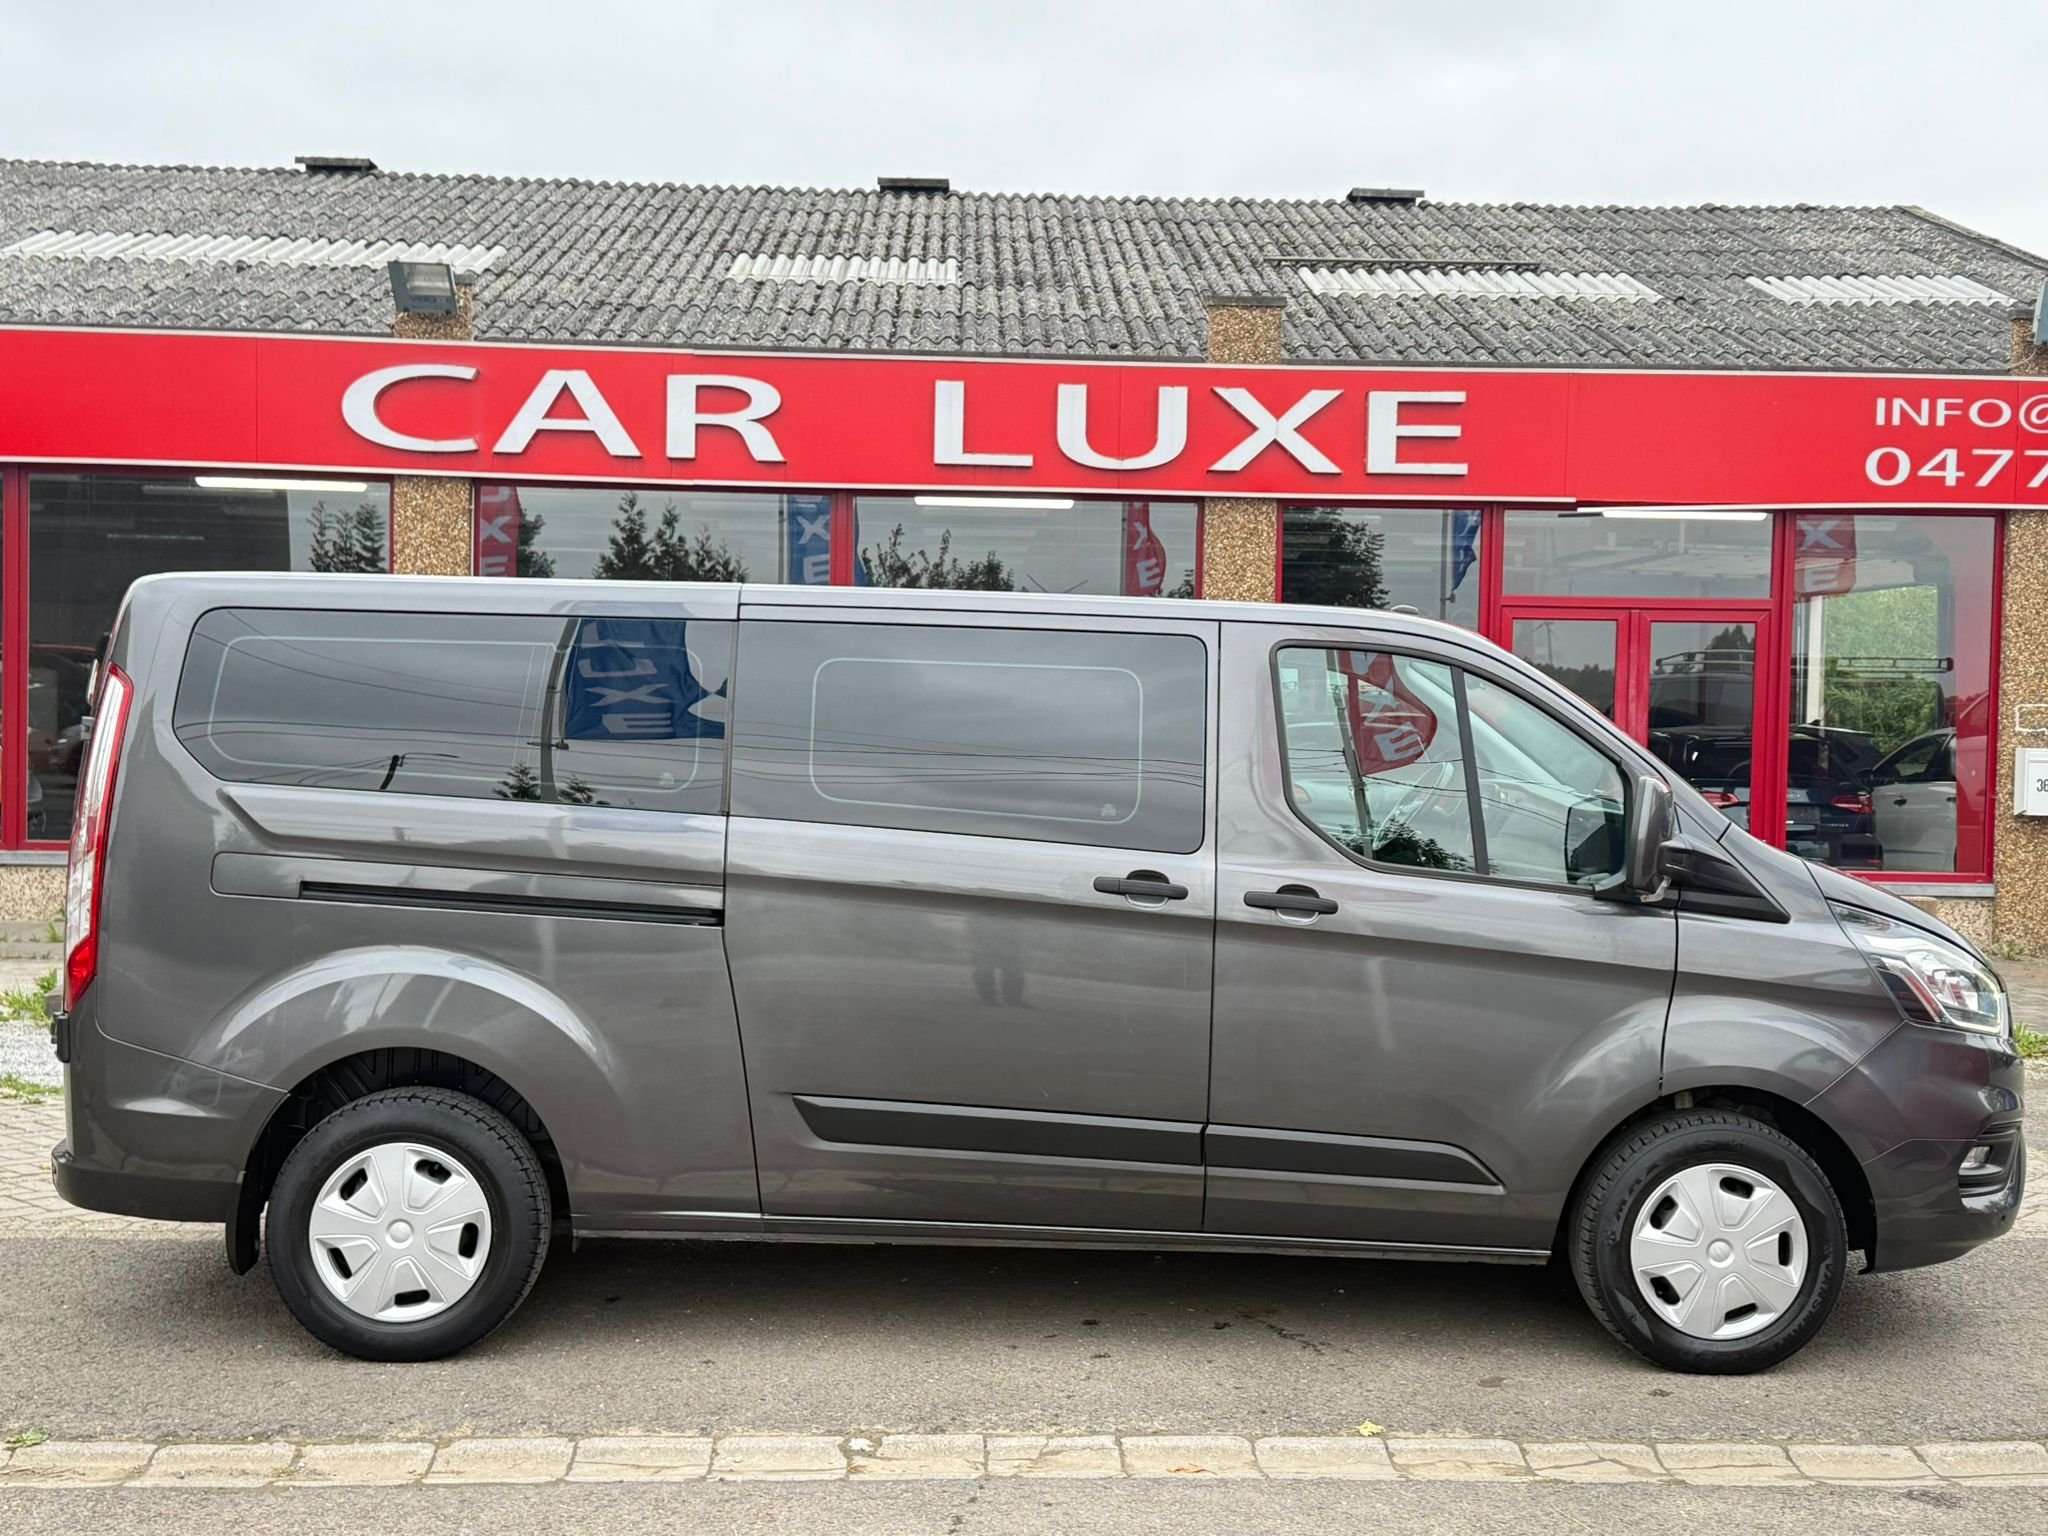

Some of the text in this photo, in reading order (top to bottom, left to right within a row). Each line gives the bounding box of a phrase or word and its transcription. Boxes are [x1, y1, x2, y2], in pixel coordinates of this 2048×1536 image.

[341, 364, 1469, 476] CAR LUXE
[1865, 446, 2048, 488] 0477
